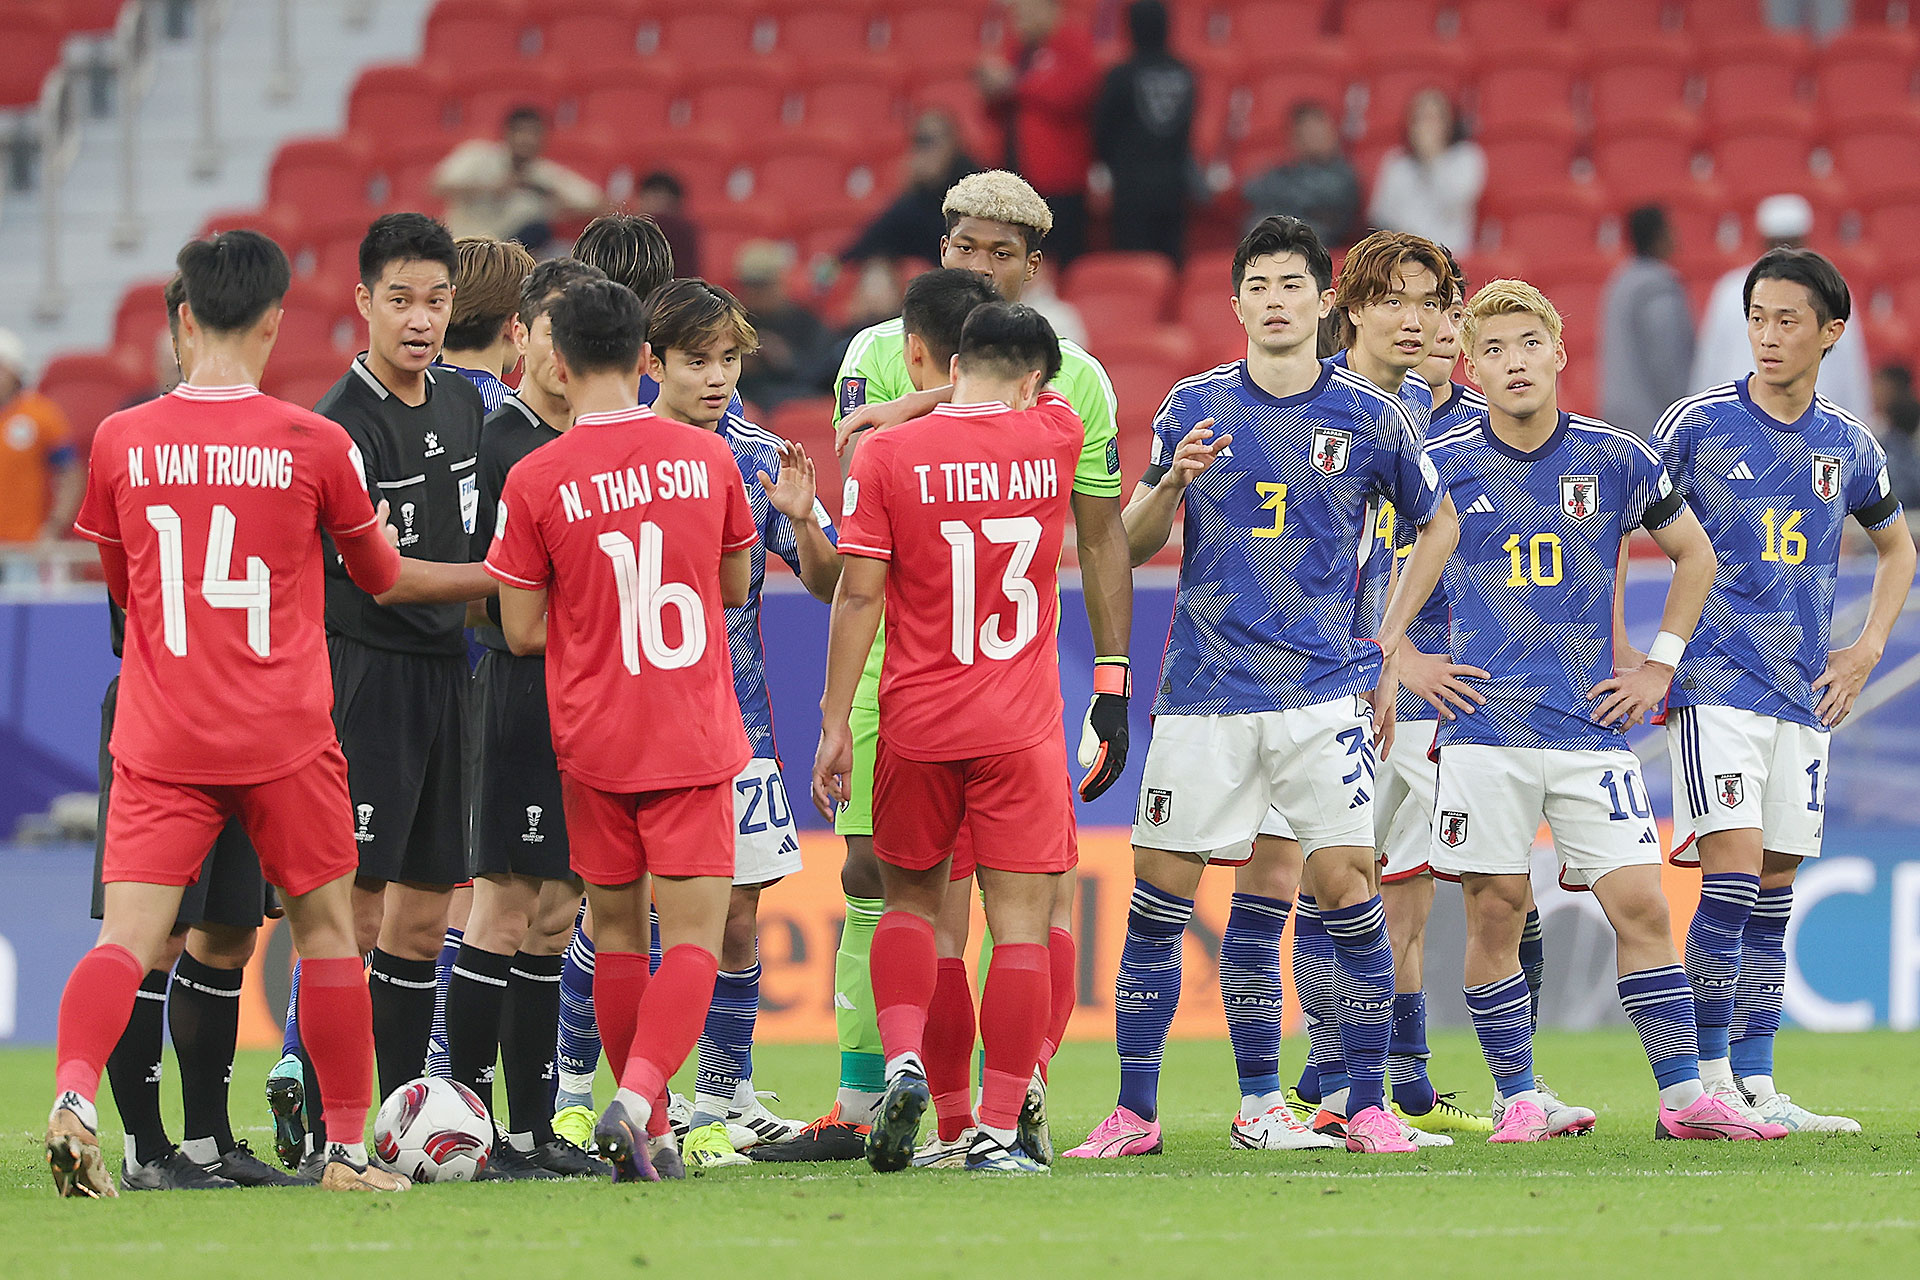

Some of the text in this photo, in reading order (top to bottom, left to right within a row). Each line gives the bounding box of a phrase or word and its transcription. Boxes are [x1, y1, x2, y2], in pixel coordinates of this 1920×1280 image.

[128, 444, 293, 489] N. VAN TRUONG
[559, 460, 710, 523] N. THAI SON
[914, 459, 1058, 503] T. TIEN ANH
[1252, 482, 1287, 538] 3
[1761, 508, 1808, 565] 16
[146, 504, 271, 657] 14
[1502, 533, 1563, 587] 10
[597, 521, 707, 676] 16
[940, 516, 1042, 665] 13
[736, 773, 790, 835] 20
[1599, 770, 1650, 820] 10
[1805, 759, 1823, 812] 1
